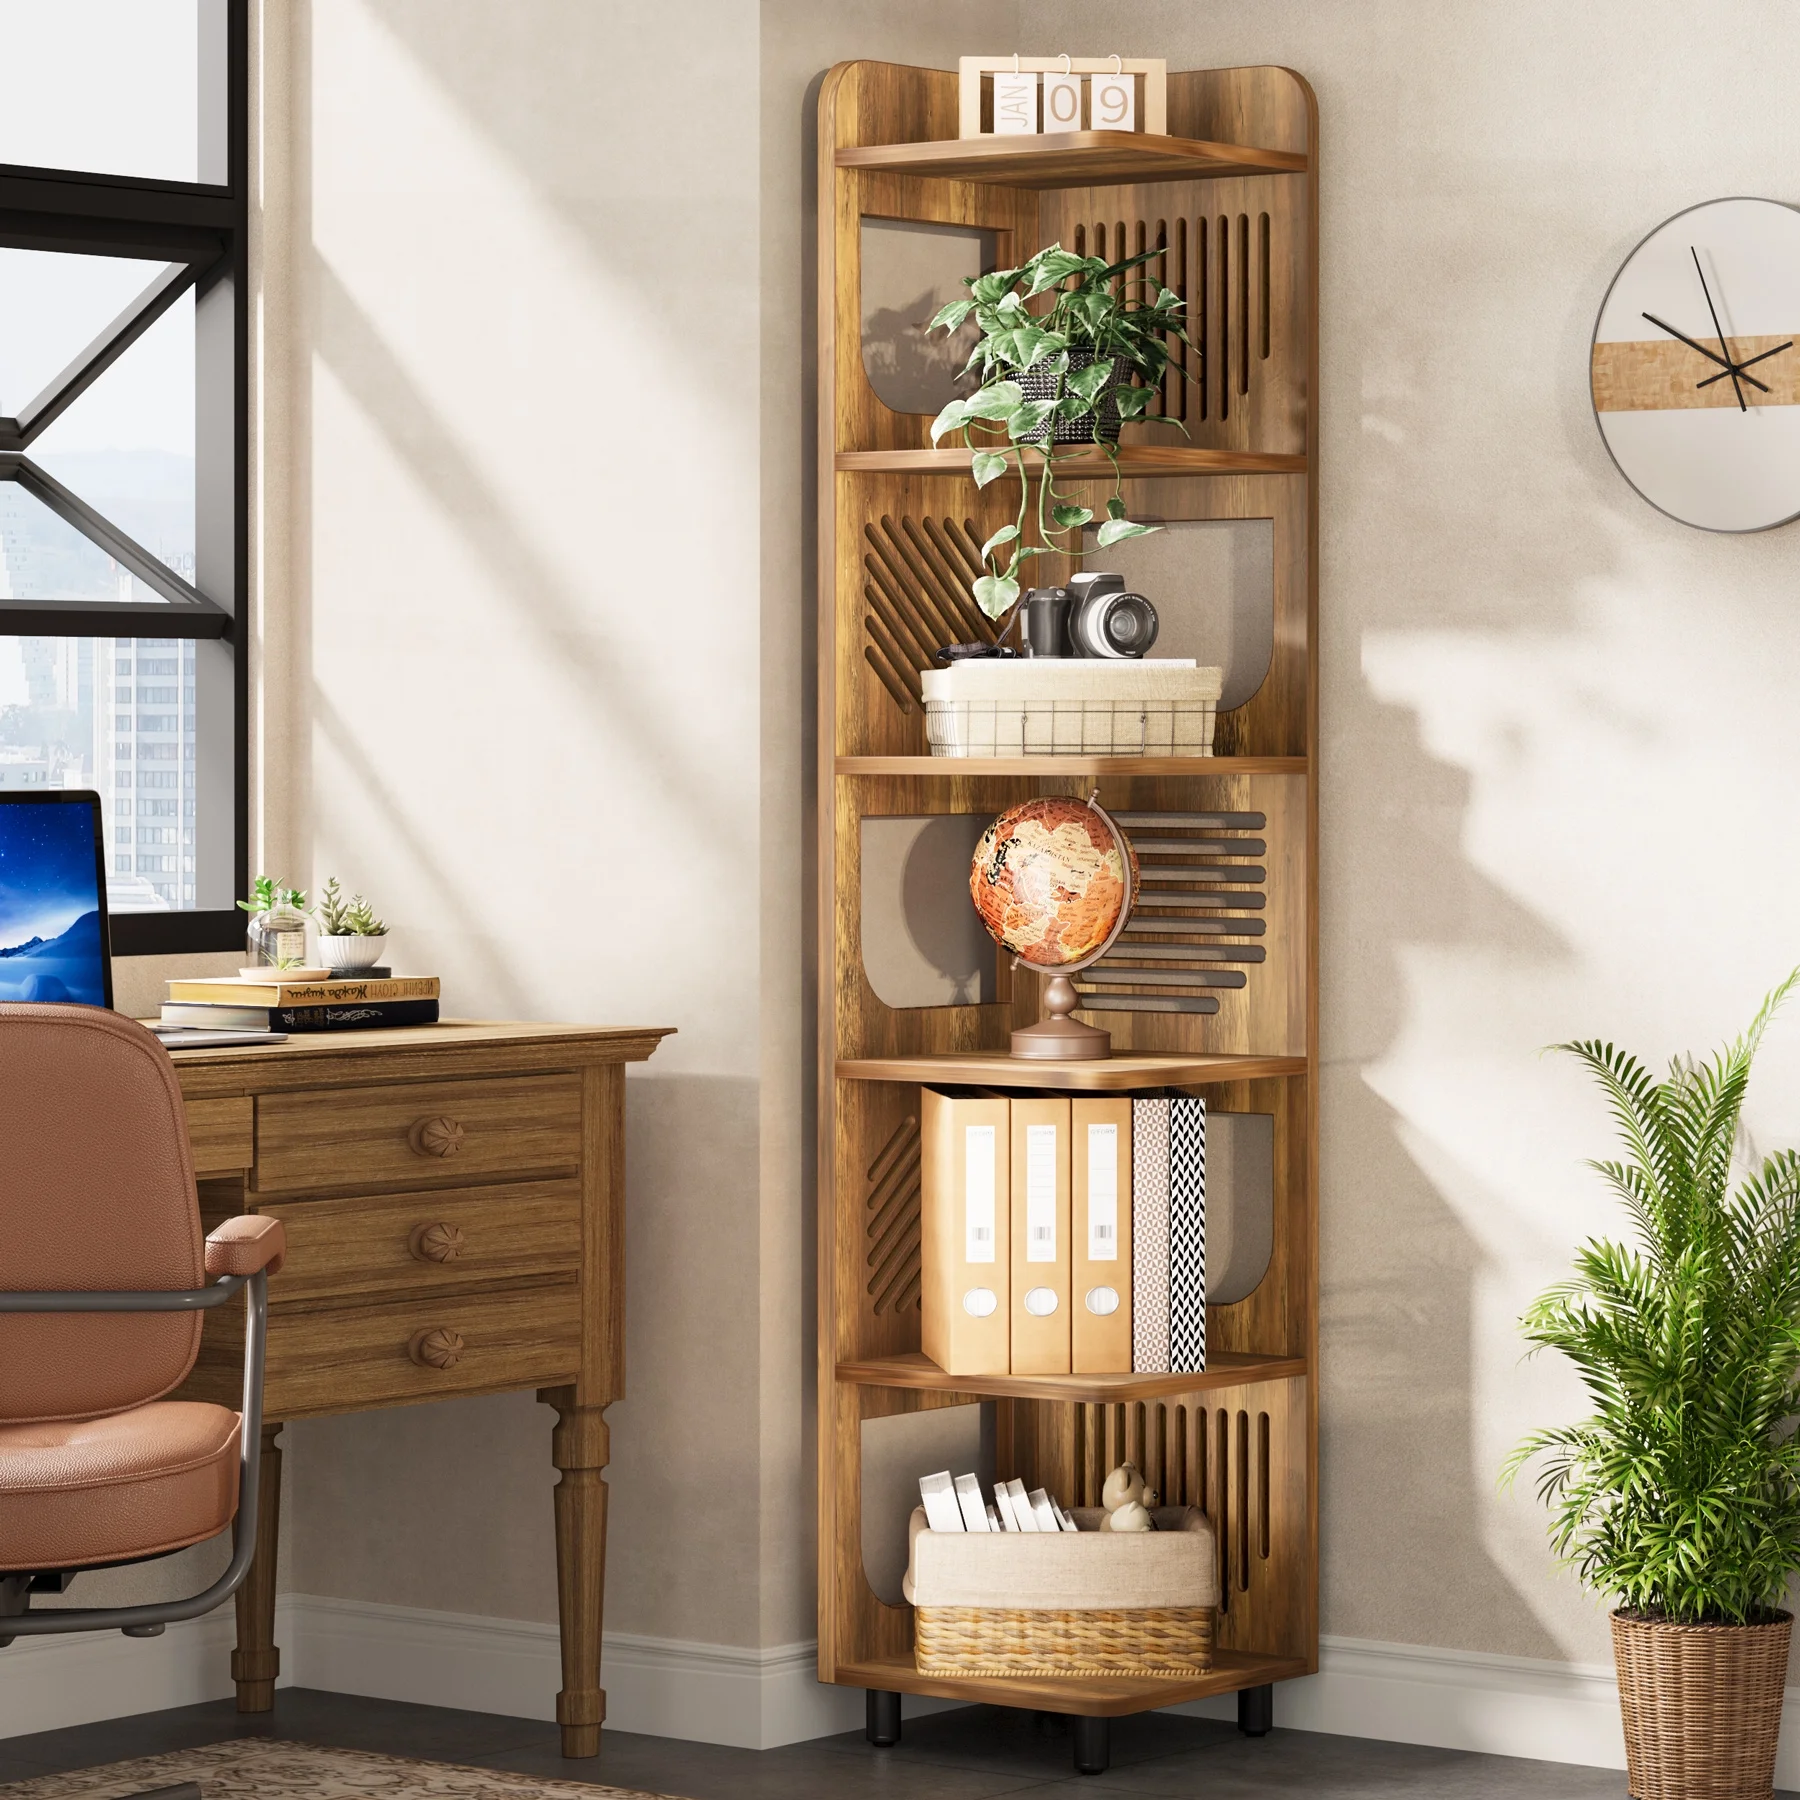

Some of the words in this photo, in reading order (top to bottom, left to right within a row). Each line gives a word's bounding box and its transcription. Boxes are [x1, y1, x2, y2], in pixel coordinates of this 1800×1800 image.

[1000, 85, 1028, 127] JAN
[287, 986, 327, 999] жизни
[327, 985, 368, 1000] Жажда
[370, 982, 398, 998] СТОУН
[400, 980, 434, 997] ИРВИНГ
